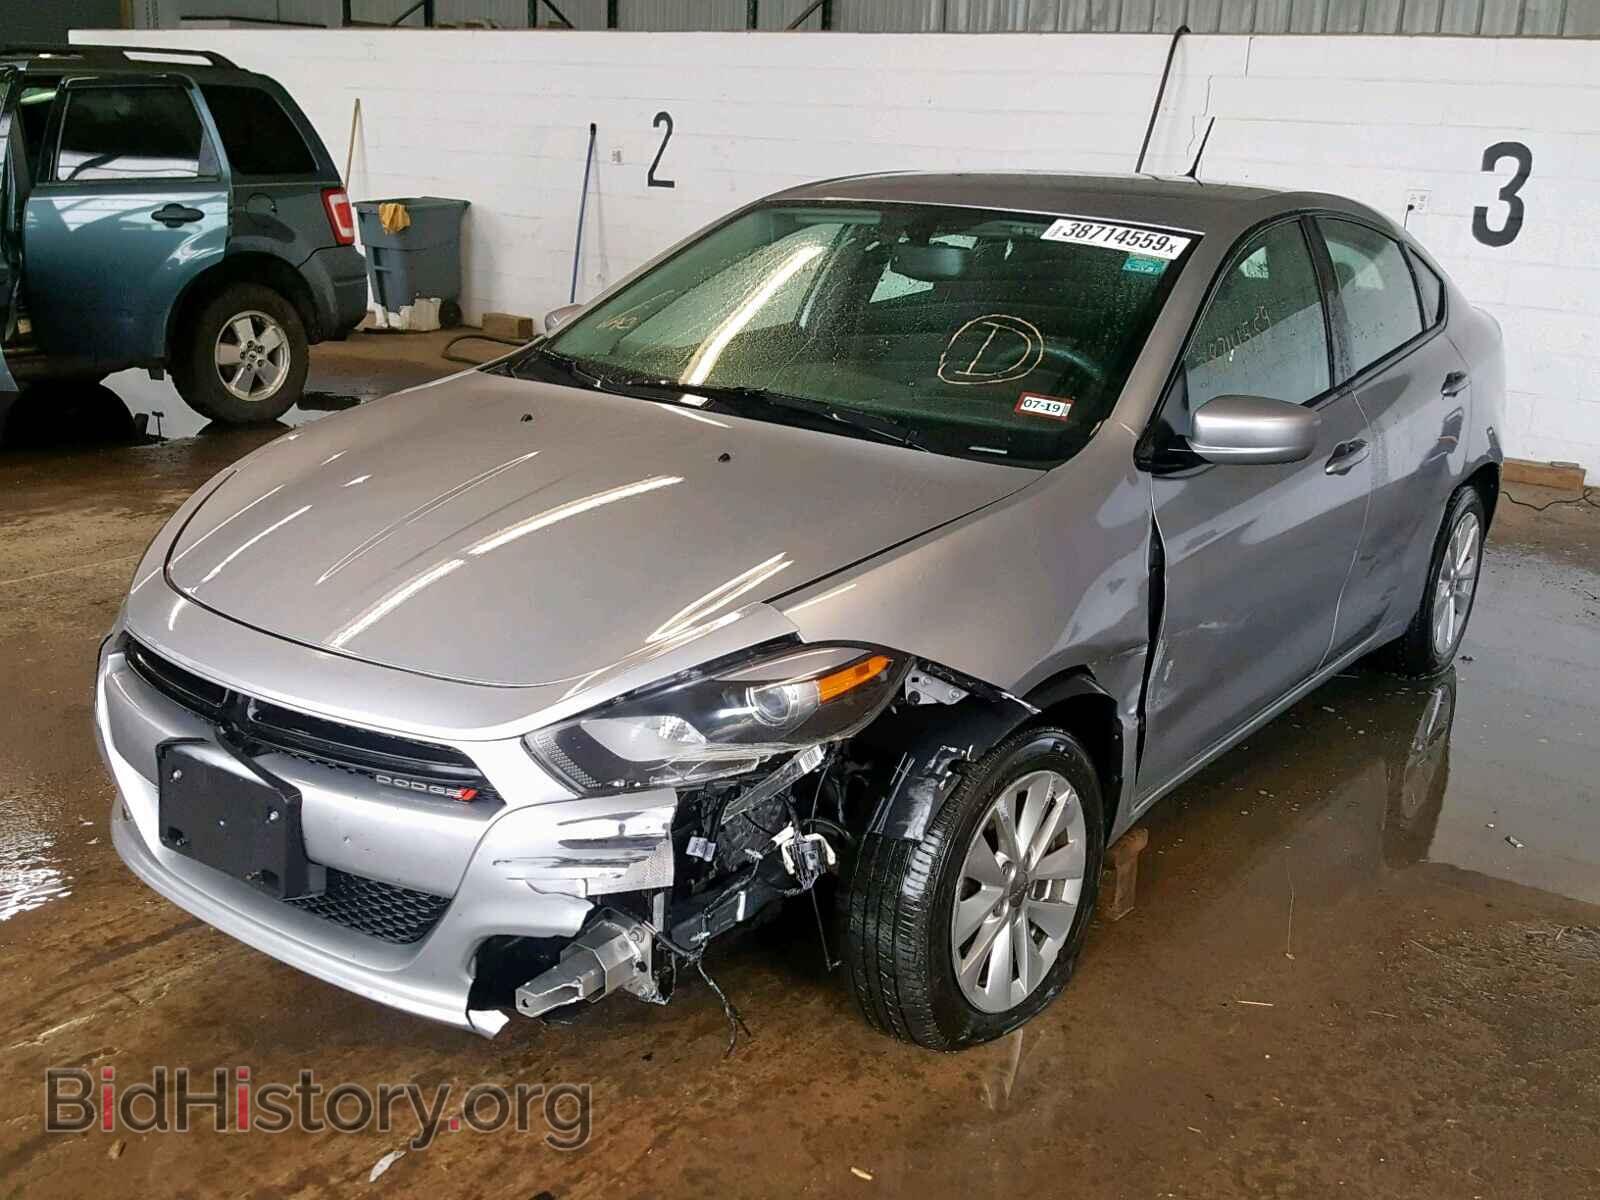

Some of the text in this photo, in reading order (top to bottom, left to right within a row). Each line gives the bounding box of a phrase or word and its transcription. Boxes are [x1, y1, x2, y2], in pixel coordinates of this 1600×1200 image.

[648, 111, 675, 188] 2
[1472, 141, 1532, 247] 3
[1023, 399, 1061, 413] 07-19
[375, 774, 463, 799] DODGE
